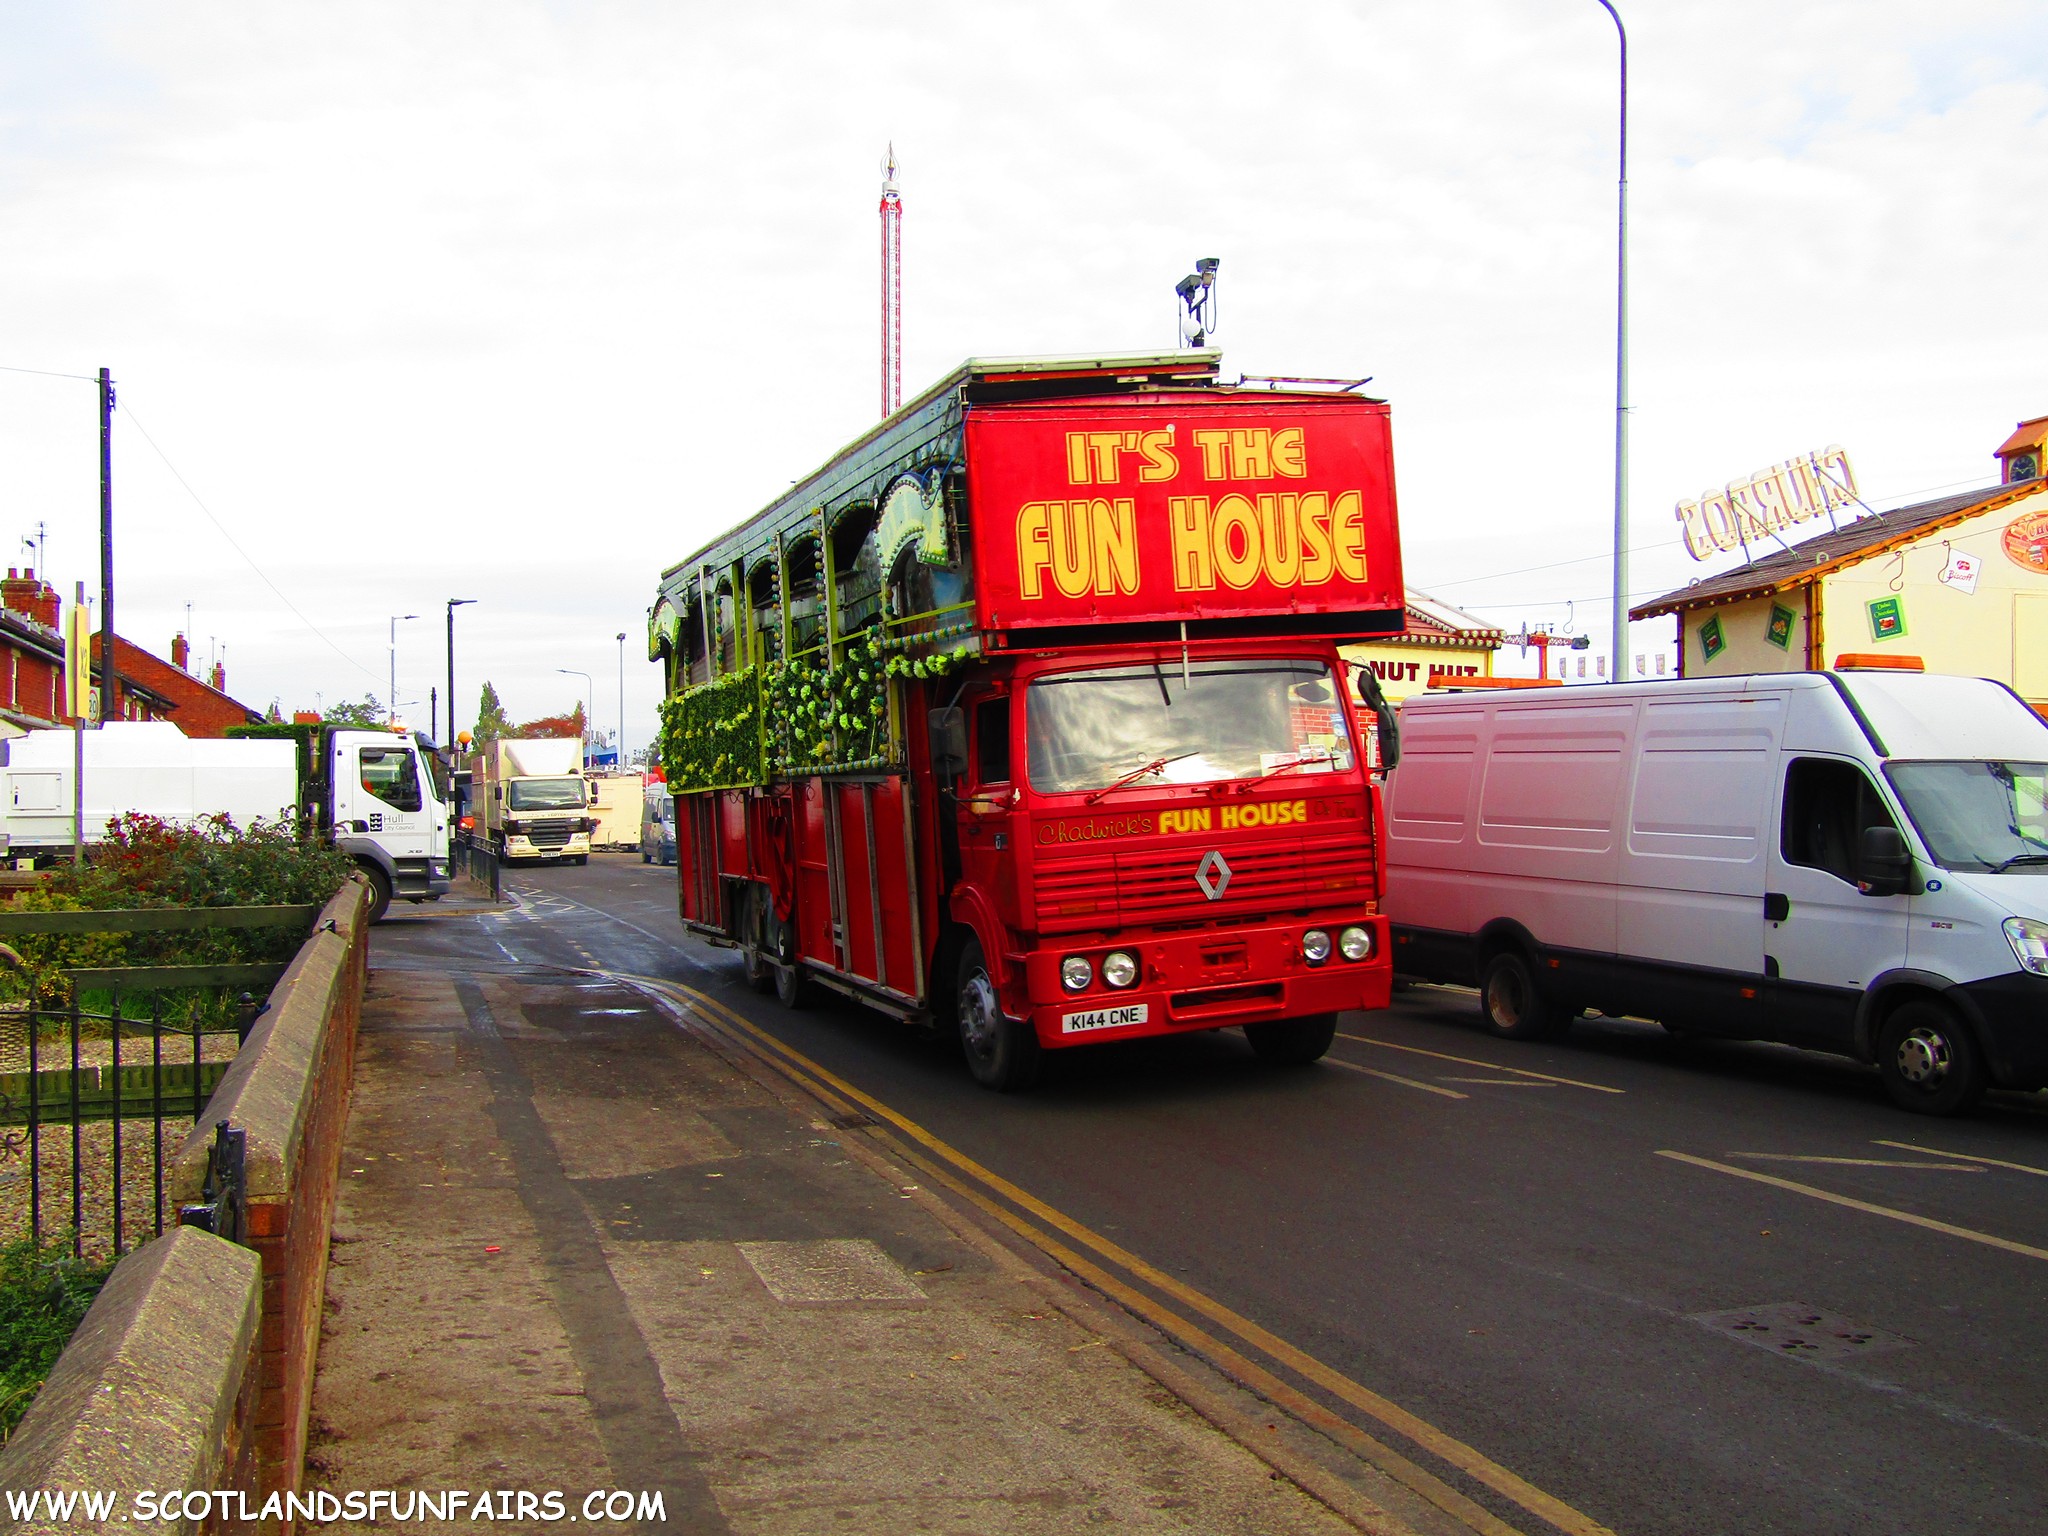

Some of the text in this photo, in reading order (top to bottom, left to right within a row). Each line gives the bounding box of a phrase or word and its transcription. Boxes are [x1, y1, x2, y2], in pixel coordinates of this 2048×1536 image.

[1065, 428, 1307, 485] IT'S THE
[1016, 489, 1368, 600] FUN HOUSE
[383, 814, 404, 823] Hull
[1038, 814, 1154, 845] Chadwick's
[1158, 808, 1212, 835] FUN
[1220, 800, 1307, 829] HOUSE
[1071, 1007, 1139, 1030] K144 CNE
